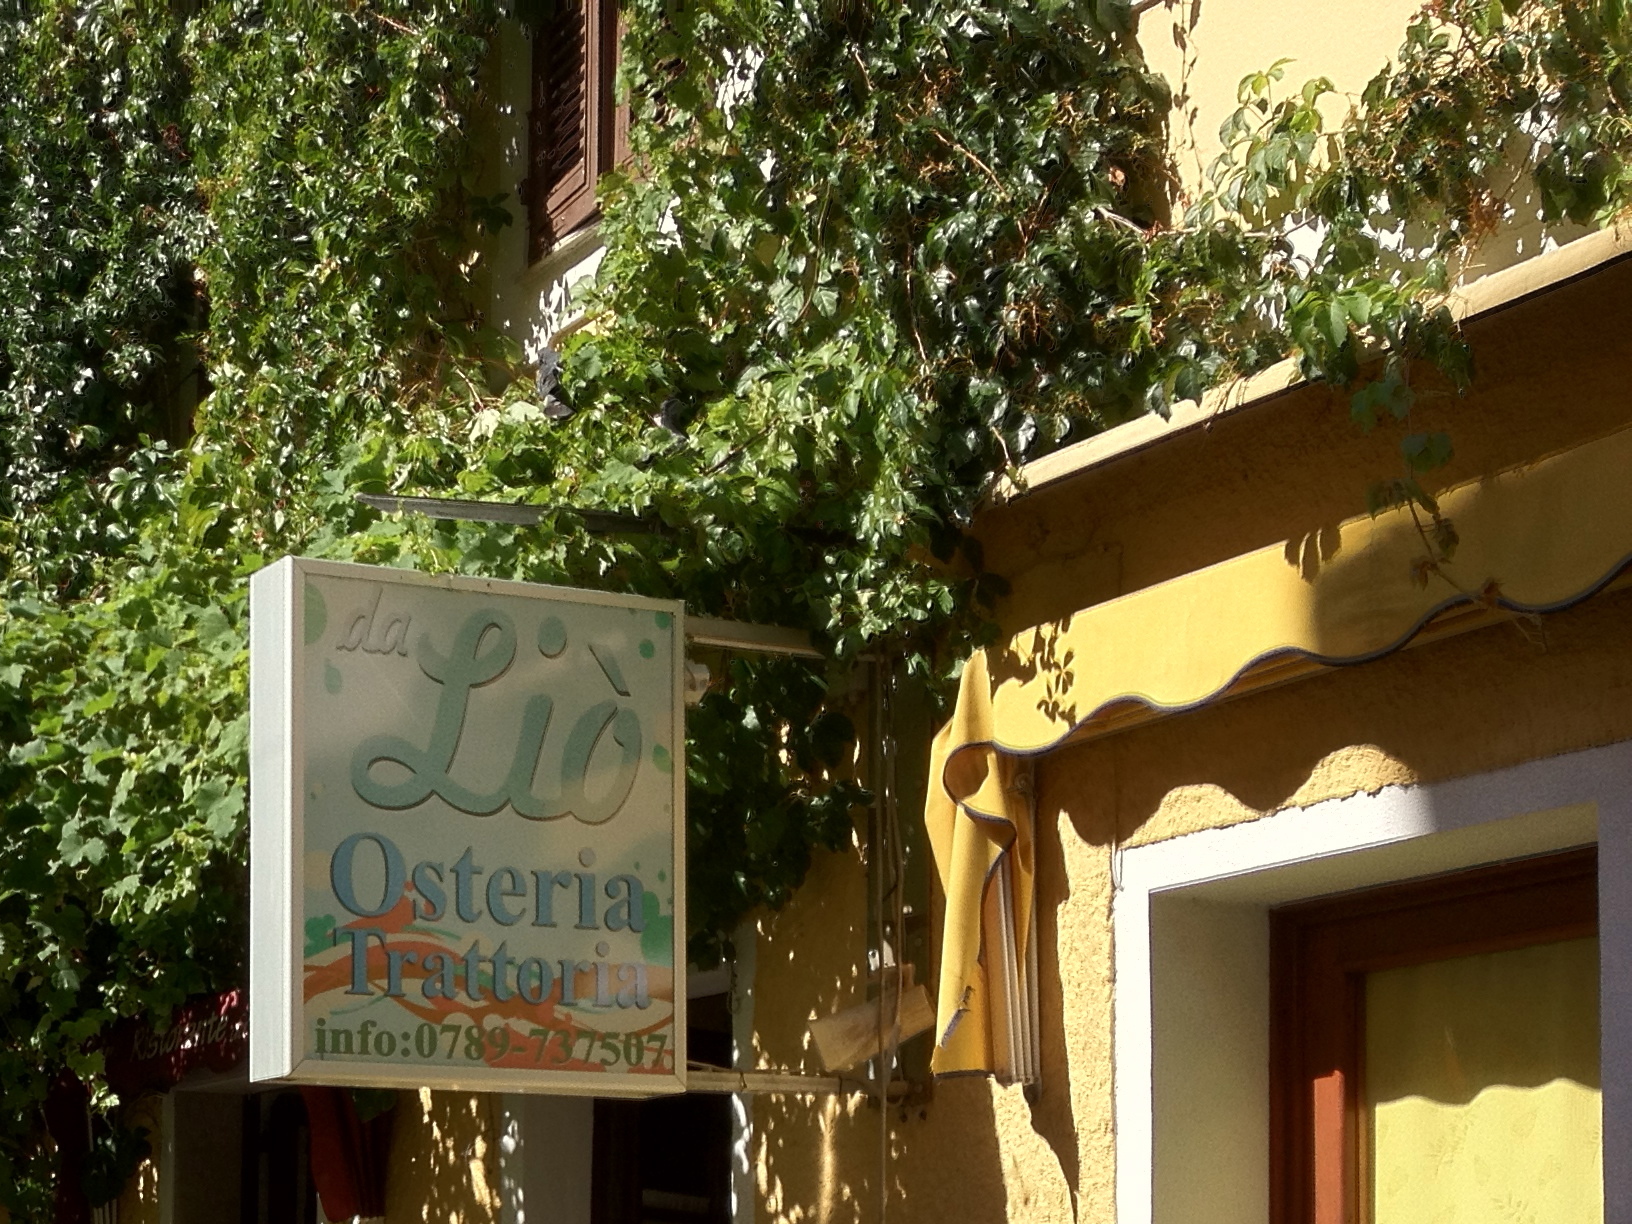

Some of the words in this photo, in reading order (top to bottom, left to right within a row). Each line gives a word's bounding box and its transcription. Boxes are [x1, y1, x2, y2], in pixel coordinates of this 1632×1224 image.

[335, 586, 412, 659] da
[352, 609, 643, 824] Liò
[330, 832, 647, 933] Osteria
[334, 929, 651, 1009] Trattoria
